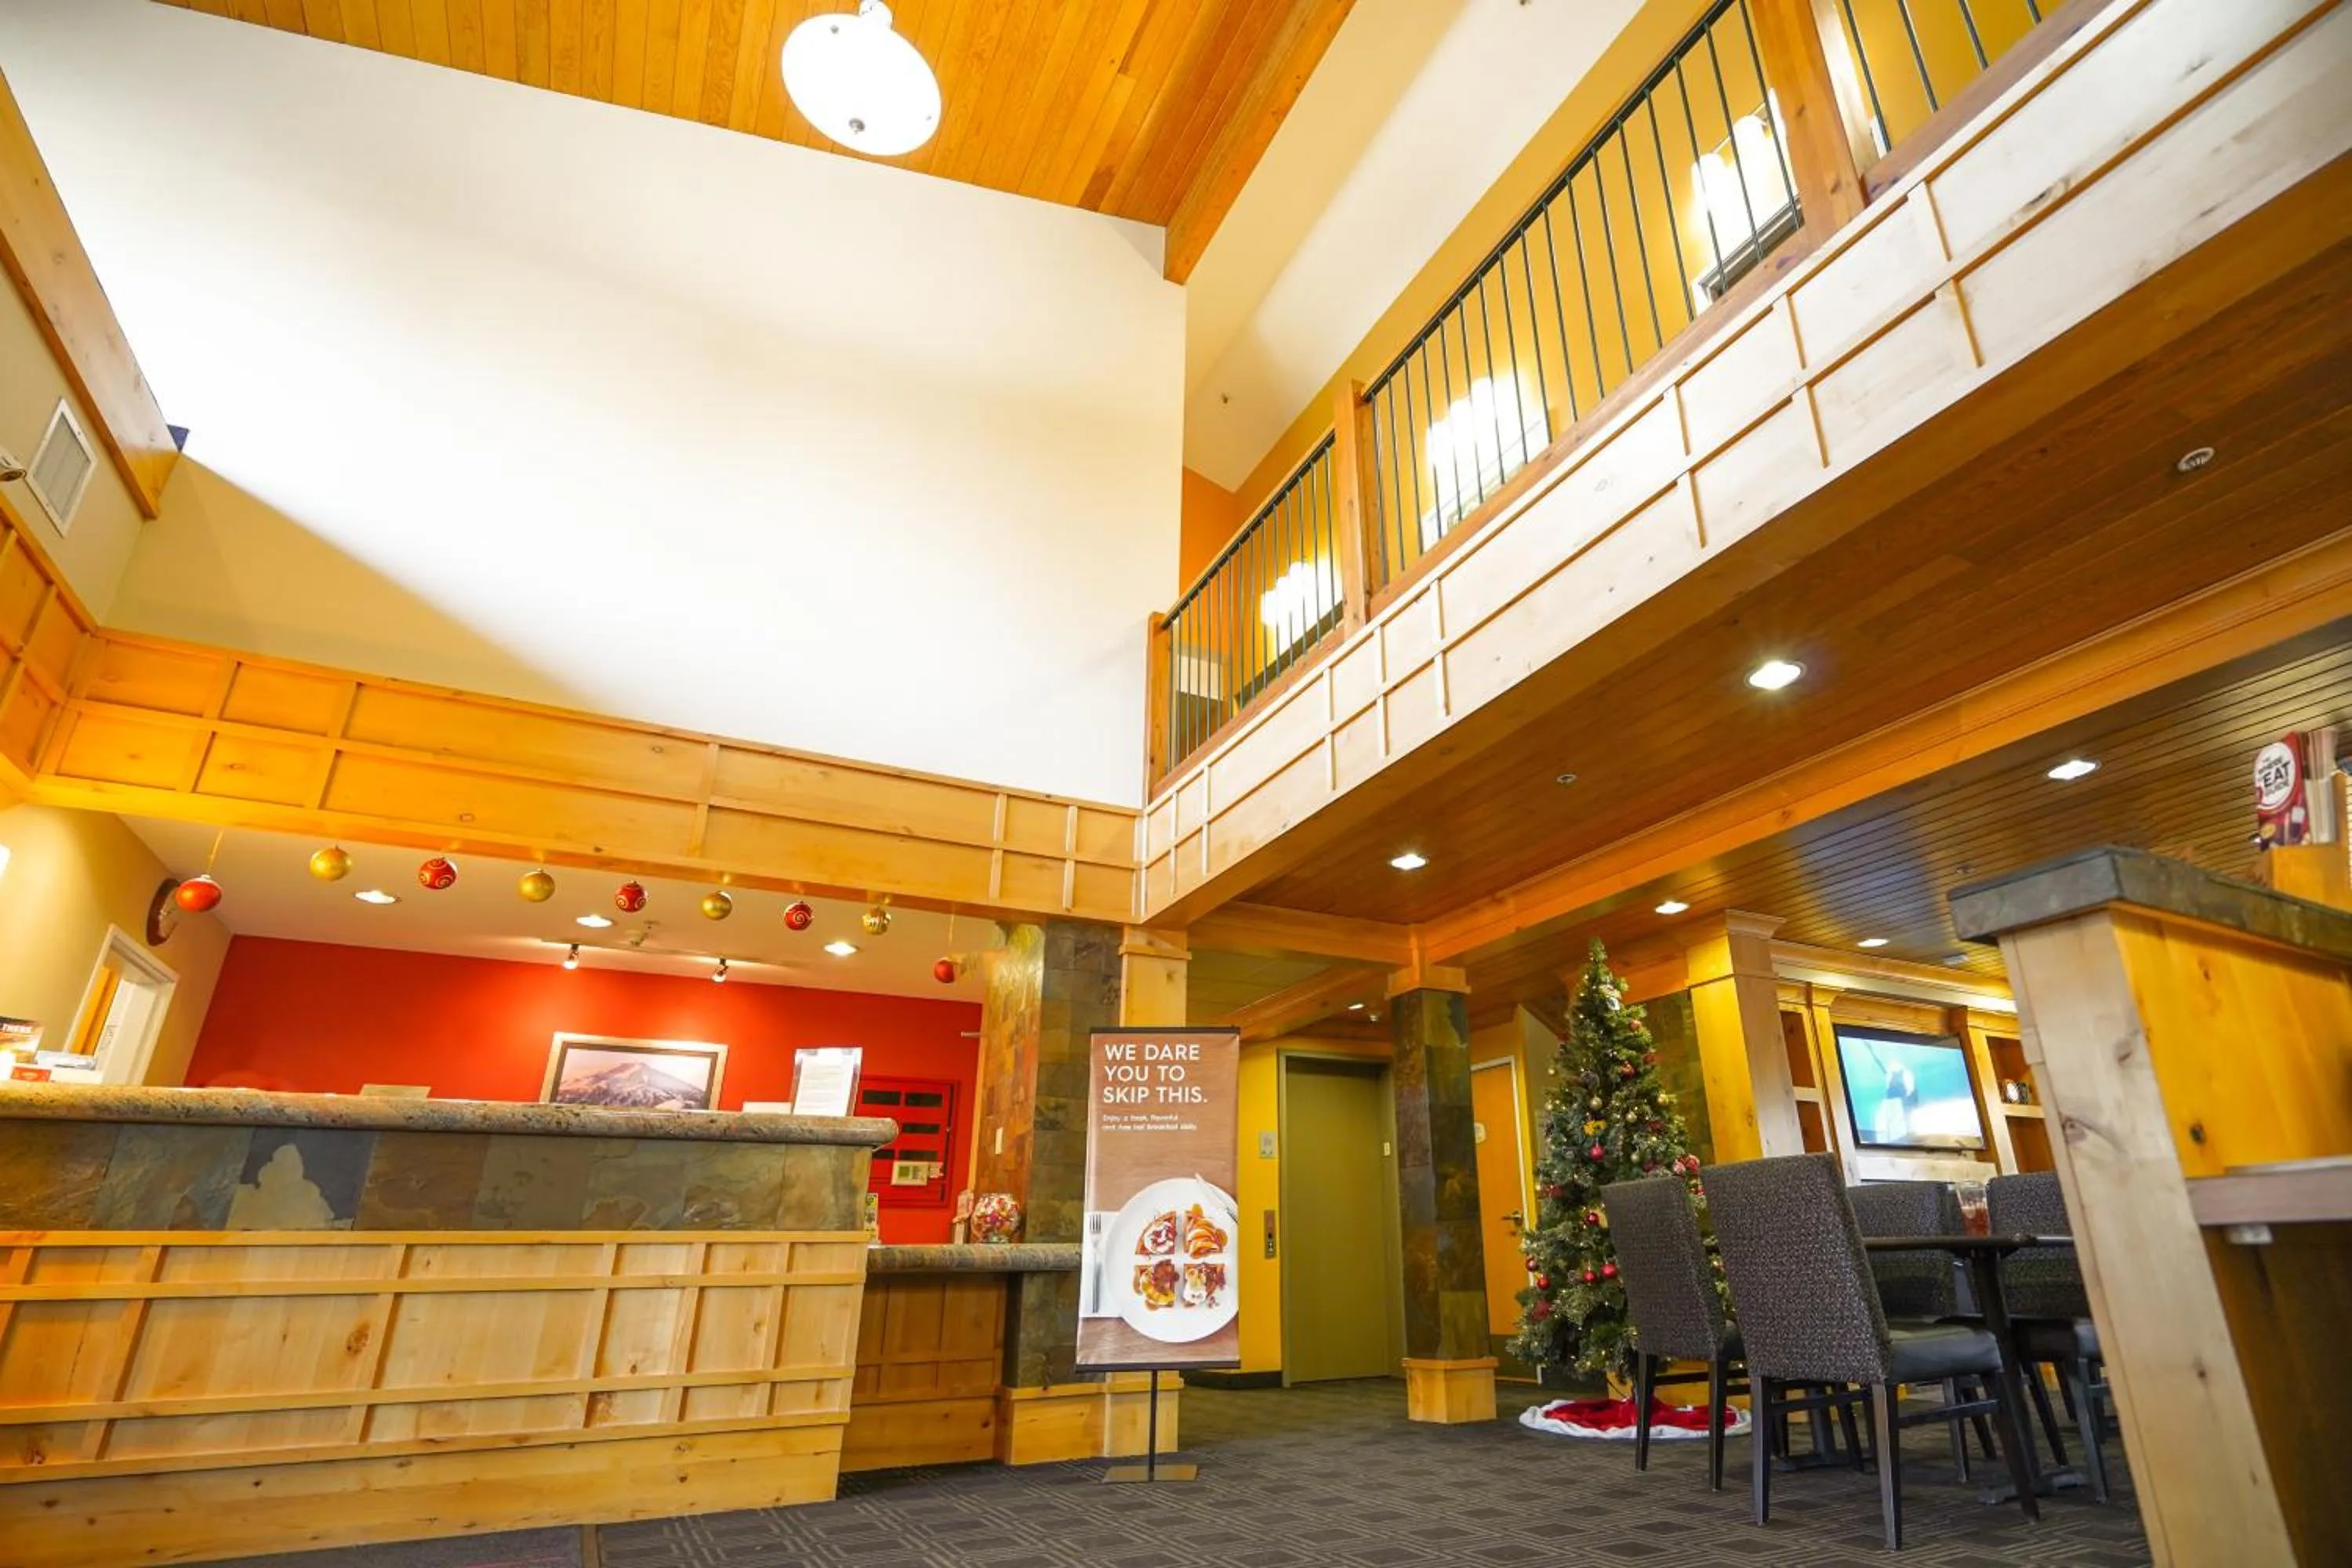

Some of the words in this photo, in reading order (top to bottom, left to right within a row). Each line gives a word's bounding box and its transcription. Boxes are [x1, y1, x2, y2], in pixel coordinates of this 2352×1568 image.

[2263, 760, 2291, 788] EAT
[1104, 1044, 1136, 1061] WE
[1145, 1044, 1200, 1061] DARE
[1104, 1065, 1149, 1082] YOU
[1156, 1065, 1185, 1082] TO
[1102, 1086, 1149, 1104] SKIP
[1156, 1086, 1208, 1104] THIS.
